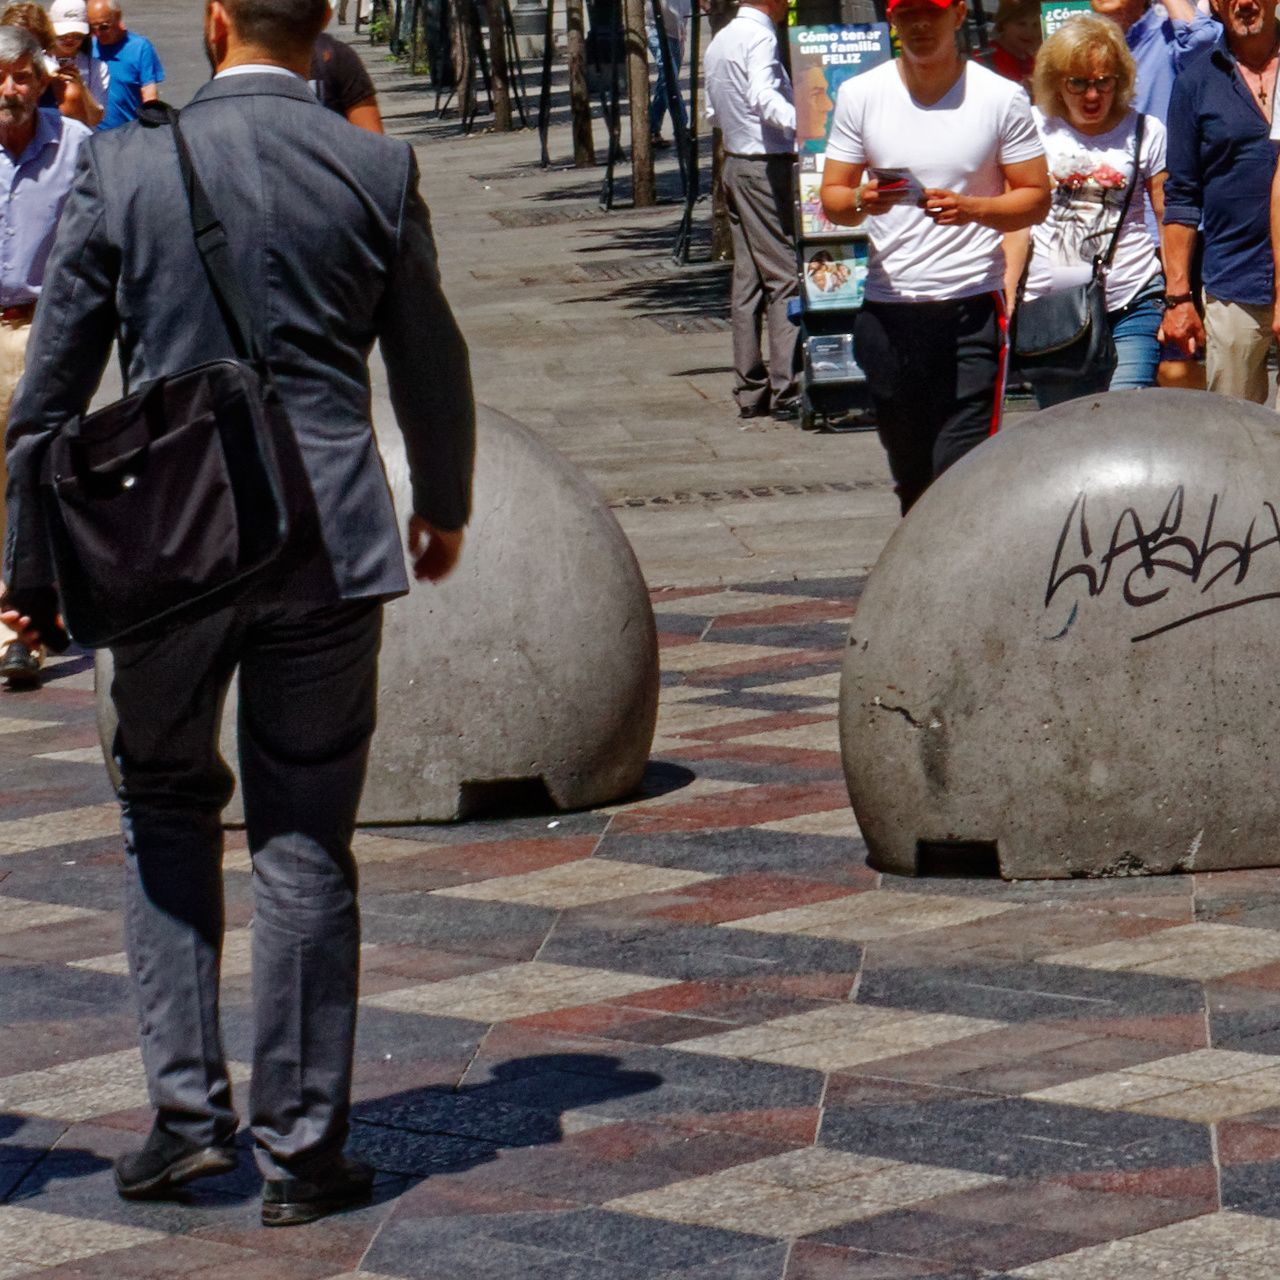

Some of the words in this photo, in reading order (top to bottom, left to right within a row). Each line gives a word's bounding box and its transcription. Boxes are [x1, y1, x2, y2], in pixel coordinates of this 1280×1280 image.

[797, 30, 839, 44] Cómo
[840, 29, 881, 41] tener
[800, 44, 828, 55] una
[830, 41, 881, 54] familia
[822, 52, 862, 66] FELIZ
